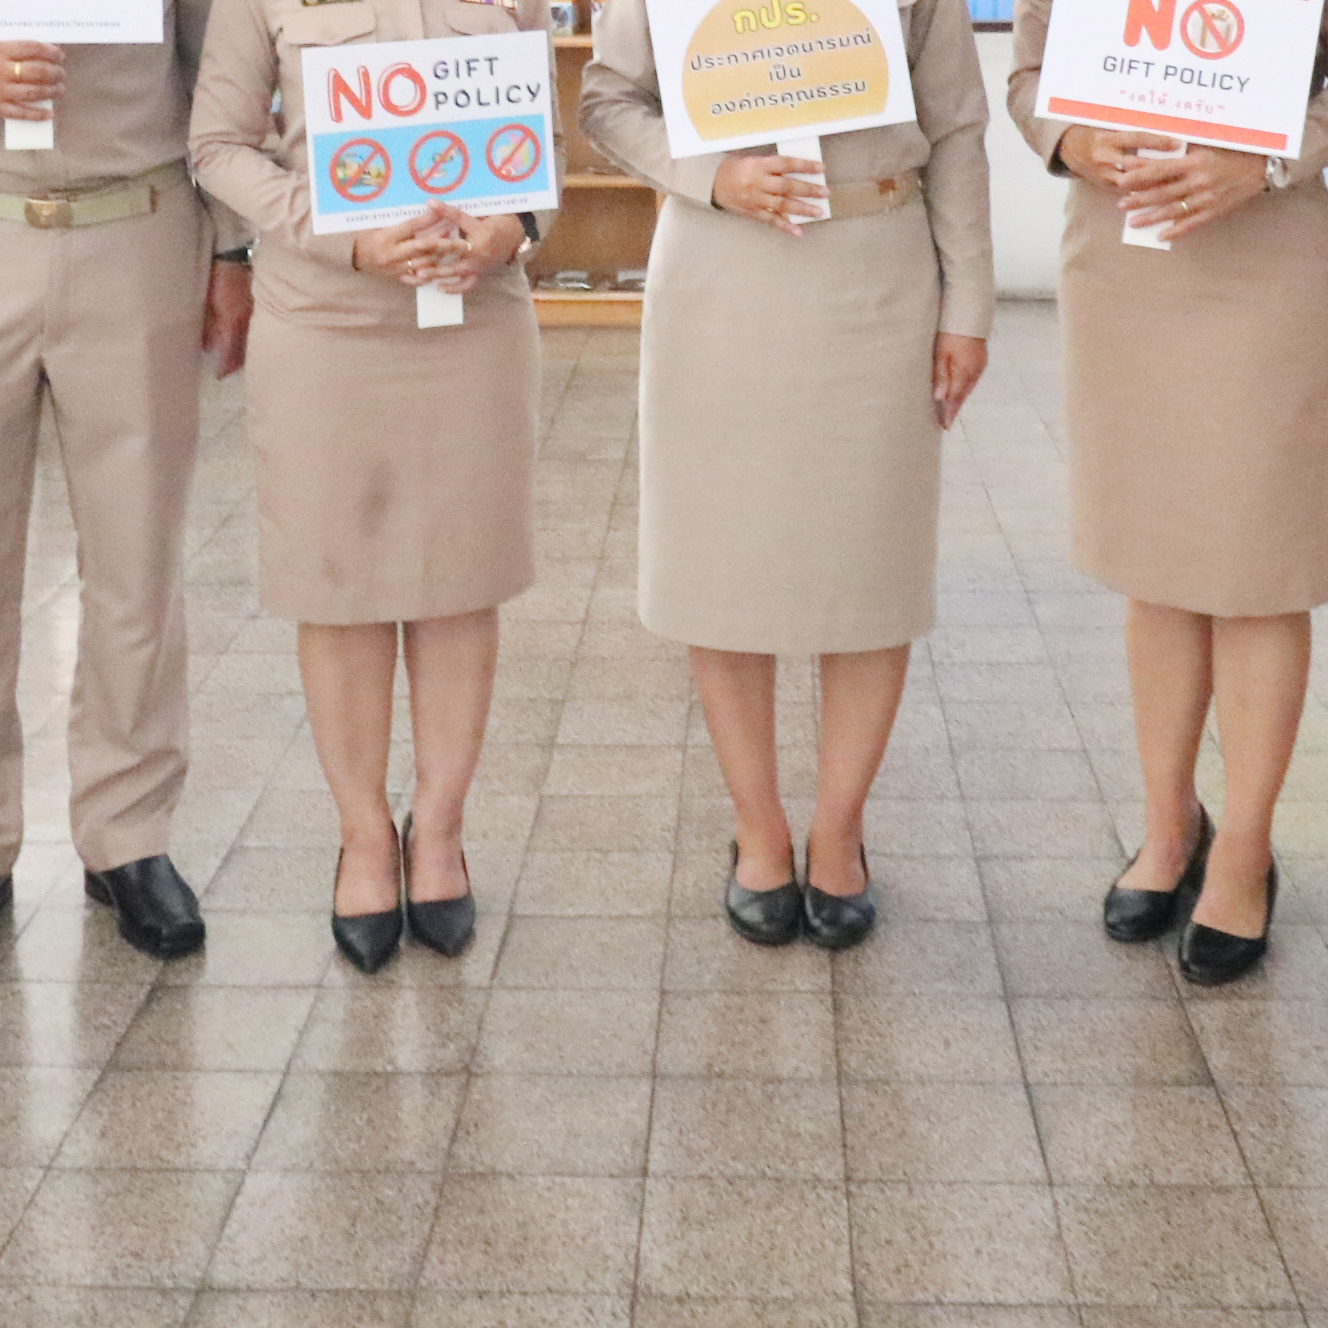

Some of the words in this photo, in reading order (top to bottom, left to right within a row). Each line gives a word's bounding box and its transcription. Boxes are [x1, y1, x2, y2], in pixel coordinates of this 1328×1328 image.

[690, 28, 874, 72] ประกาศเจตนารมณ์
[327, 62, 427, 123] NO
[433, 56, 499, 80] GIFT
[769, 64, 802, 83] เป็น
[1103, 56, 1156, 78] GIFT
[1163, 65, 1250, 93] POLICY
[434, 83, 541, 111] POLICY
[710, 79, 867, 116] องค์กรคุณธรรม
